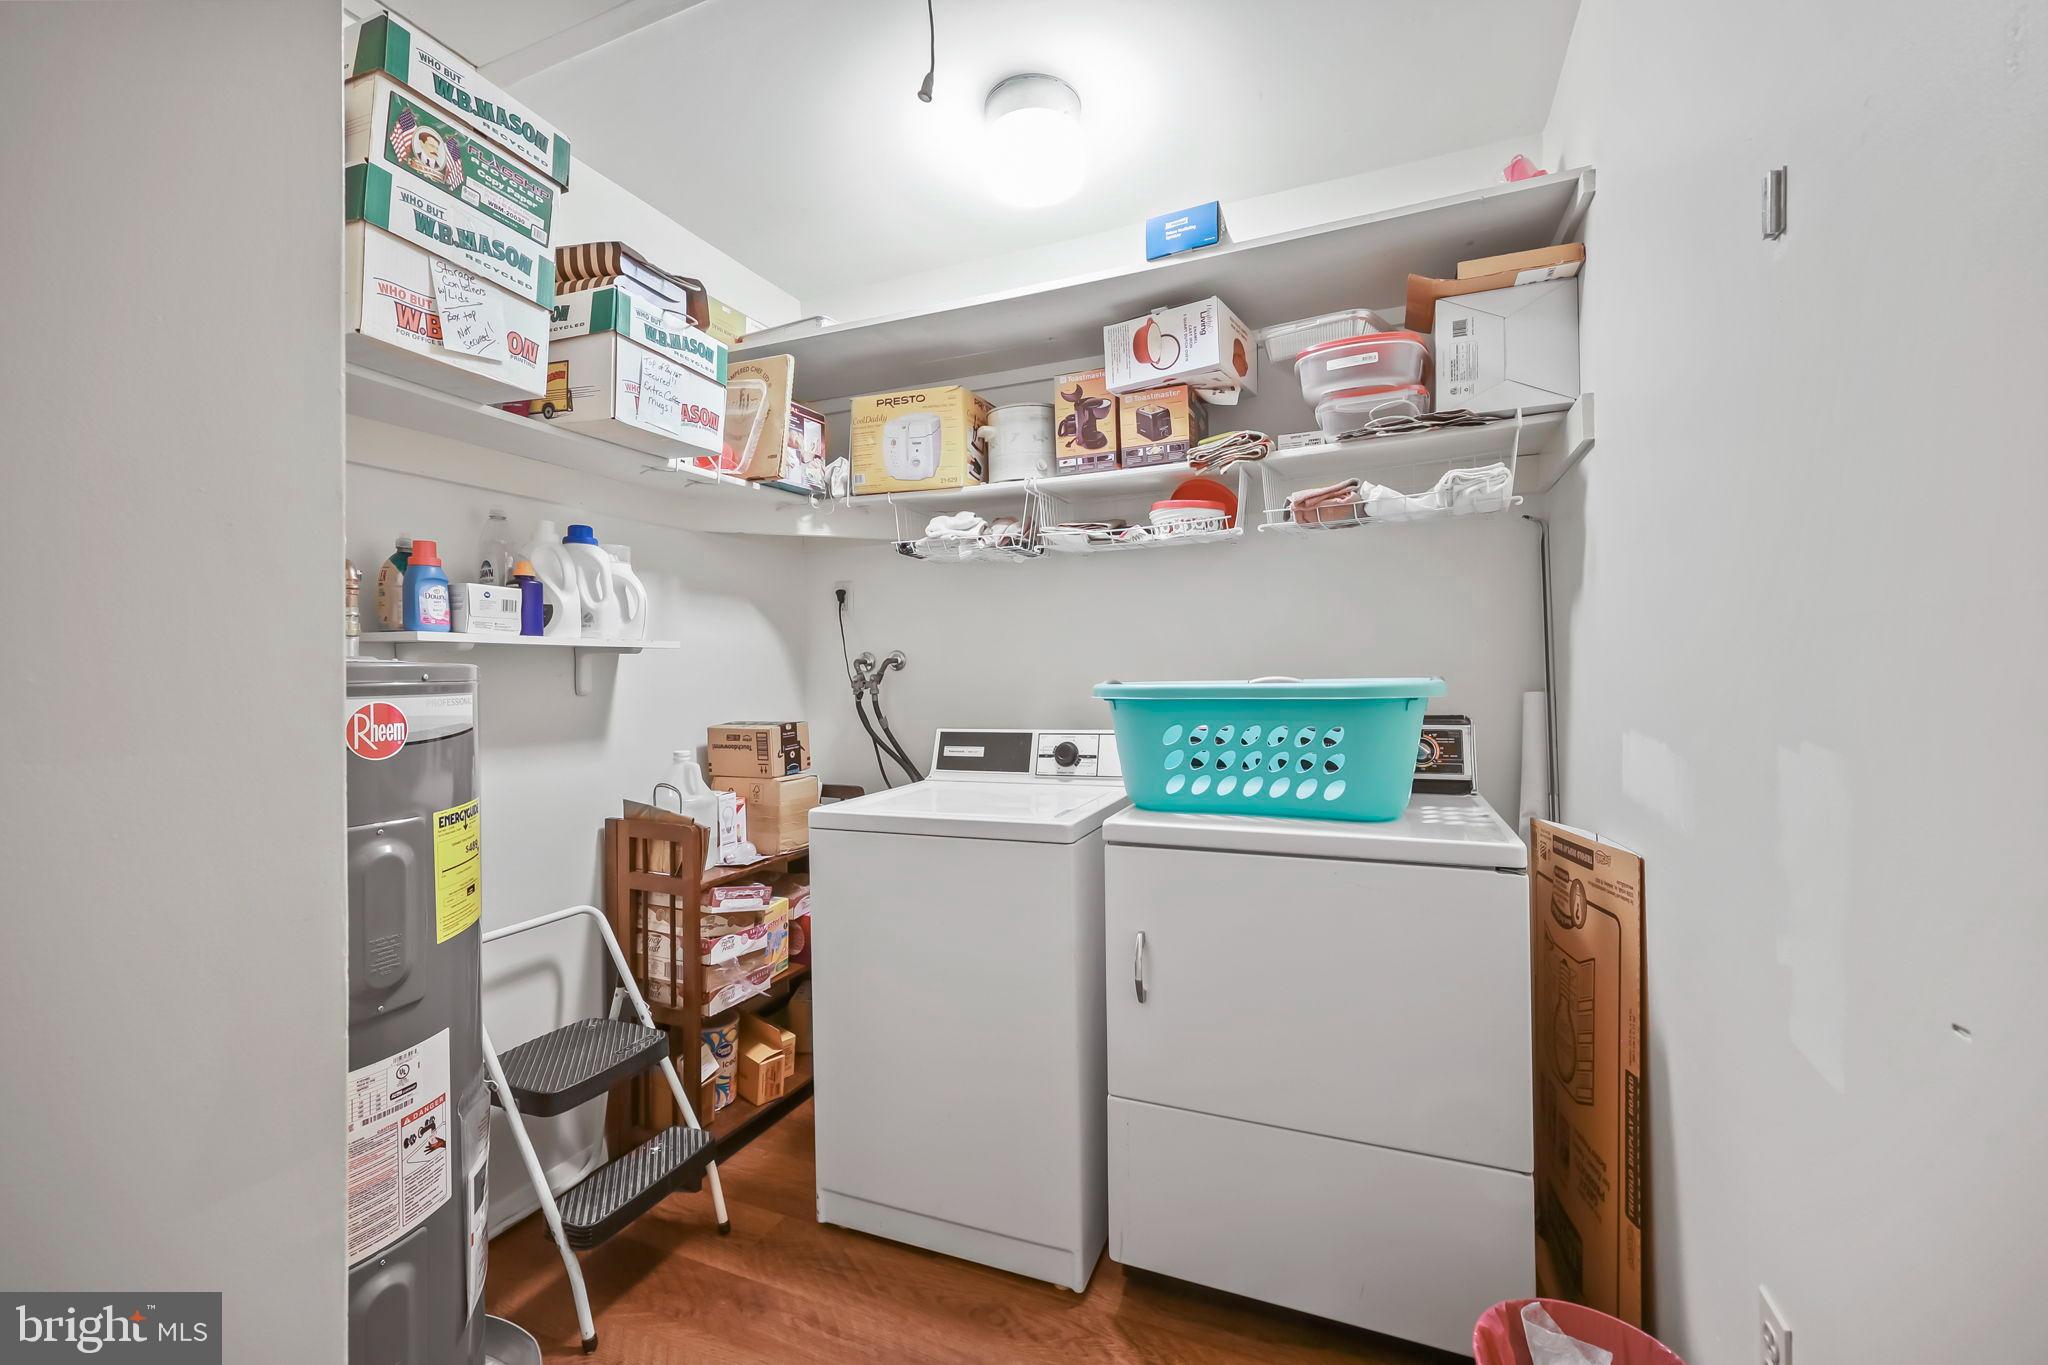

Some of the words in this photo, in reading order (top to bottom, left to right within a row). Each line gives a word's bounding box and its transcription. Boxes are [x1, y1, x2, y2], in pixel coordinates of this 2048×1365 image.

[418, 52, 441, 71] WHO
[443, 67, 463, 84] BUT
[482, 121, 549, 167] RECYCLED
[471, 157, 543, 203] RECYCLED
[477, 169, 504, 189] Copy
[507, 186, 537, 208] Paper
[400, 192, 423, 209] WHO
[426, 205, 444, 220] BUT
[465, 254, 533, 290] RECYCLED
[378, 281, 407, 300] WHO
[410, 293, 432, 309] BUT
[636, 309, 650, 321] WHO
[1200, 311, 1208, 336] Living
[396, 328, 411, 340] FOR
[412, 333, 437, 346] OFFICE
[674, 350, 715, 374] RECYCLED
[876, 394, 926, 408] PRESTO
[1133, 389, 1181, 402] Toastmaster
[353, 713, 405, 750] Rheem
[412, 1096, 446, 1119] DANGER
